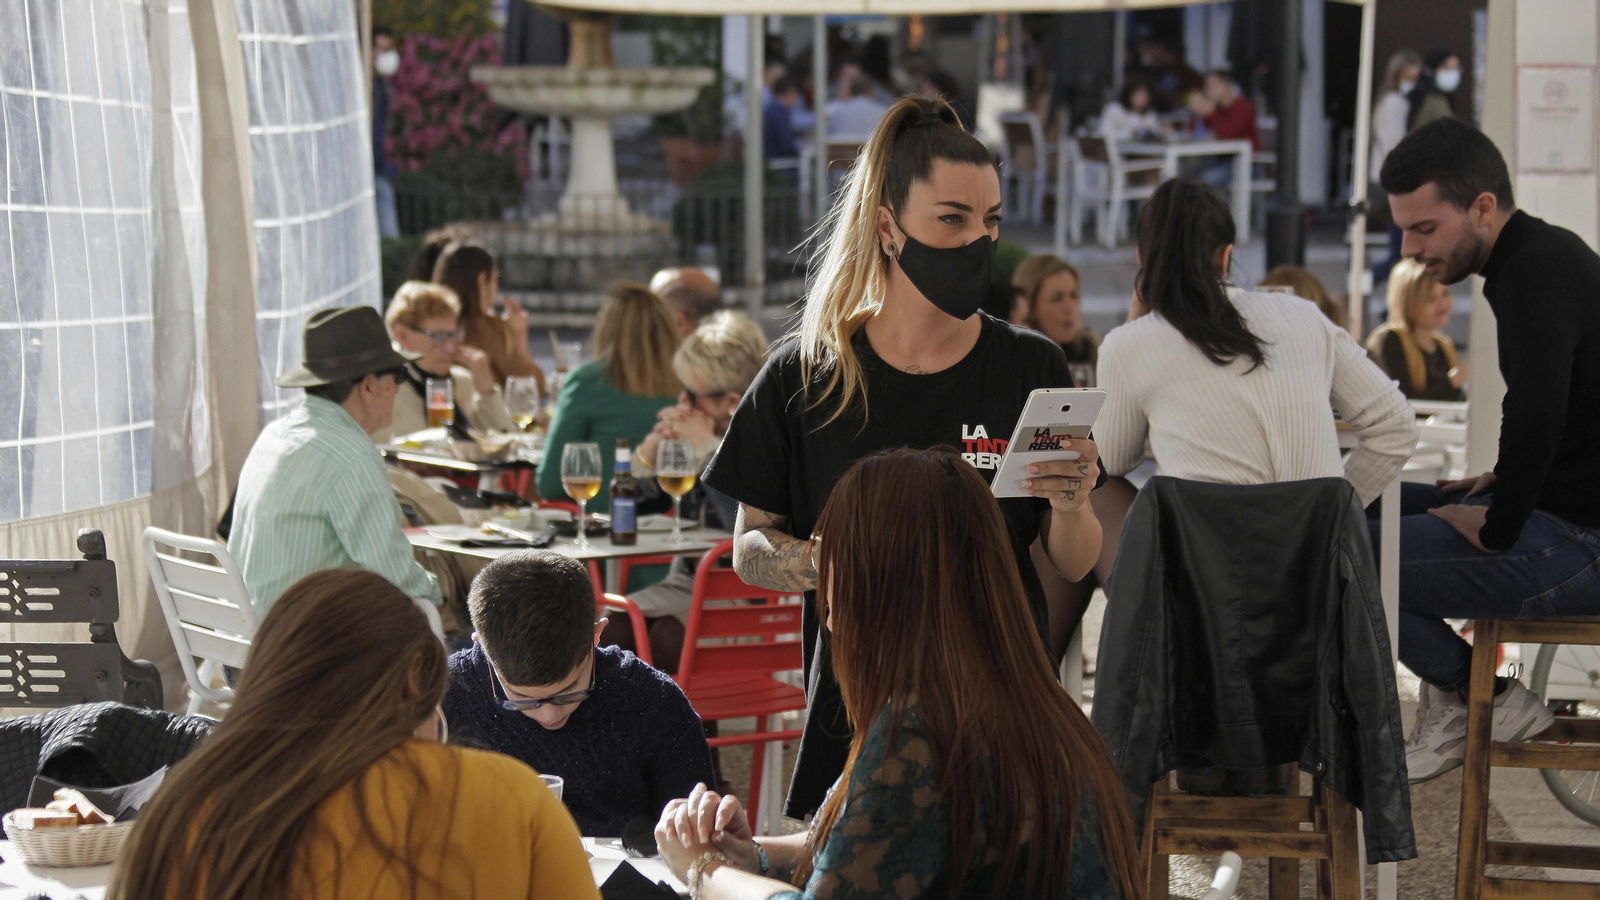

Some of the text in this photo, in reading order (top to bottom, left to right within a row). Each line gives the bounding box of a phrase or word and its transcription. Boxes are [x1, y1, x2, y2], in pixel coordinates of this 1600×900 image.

[962, 424, 989, 439] LA
[1034, 427, 1050, 436] LA
[961, 452, 1004, 470] RER
